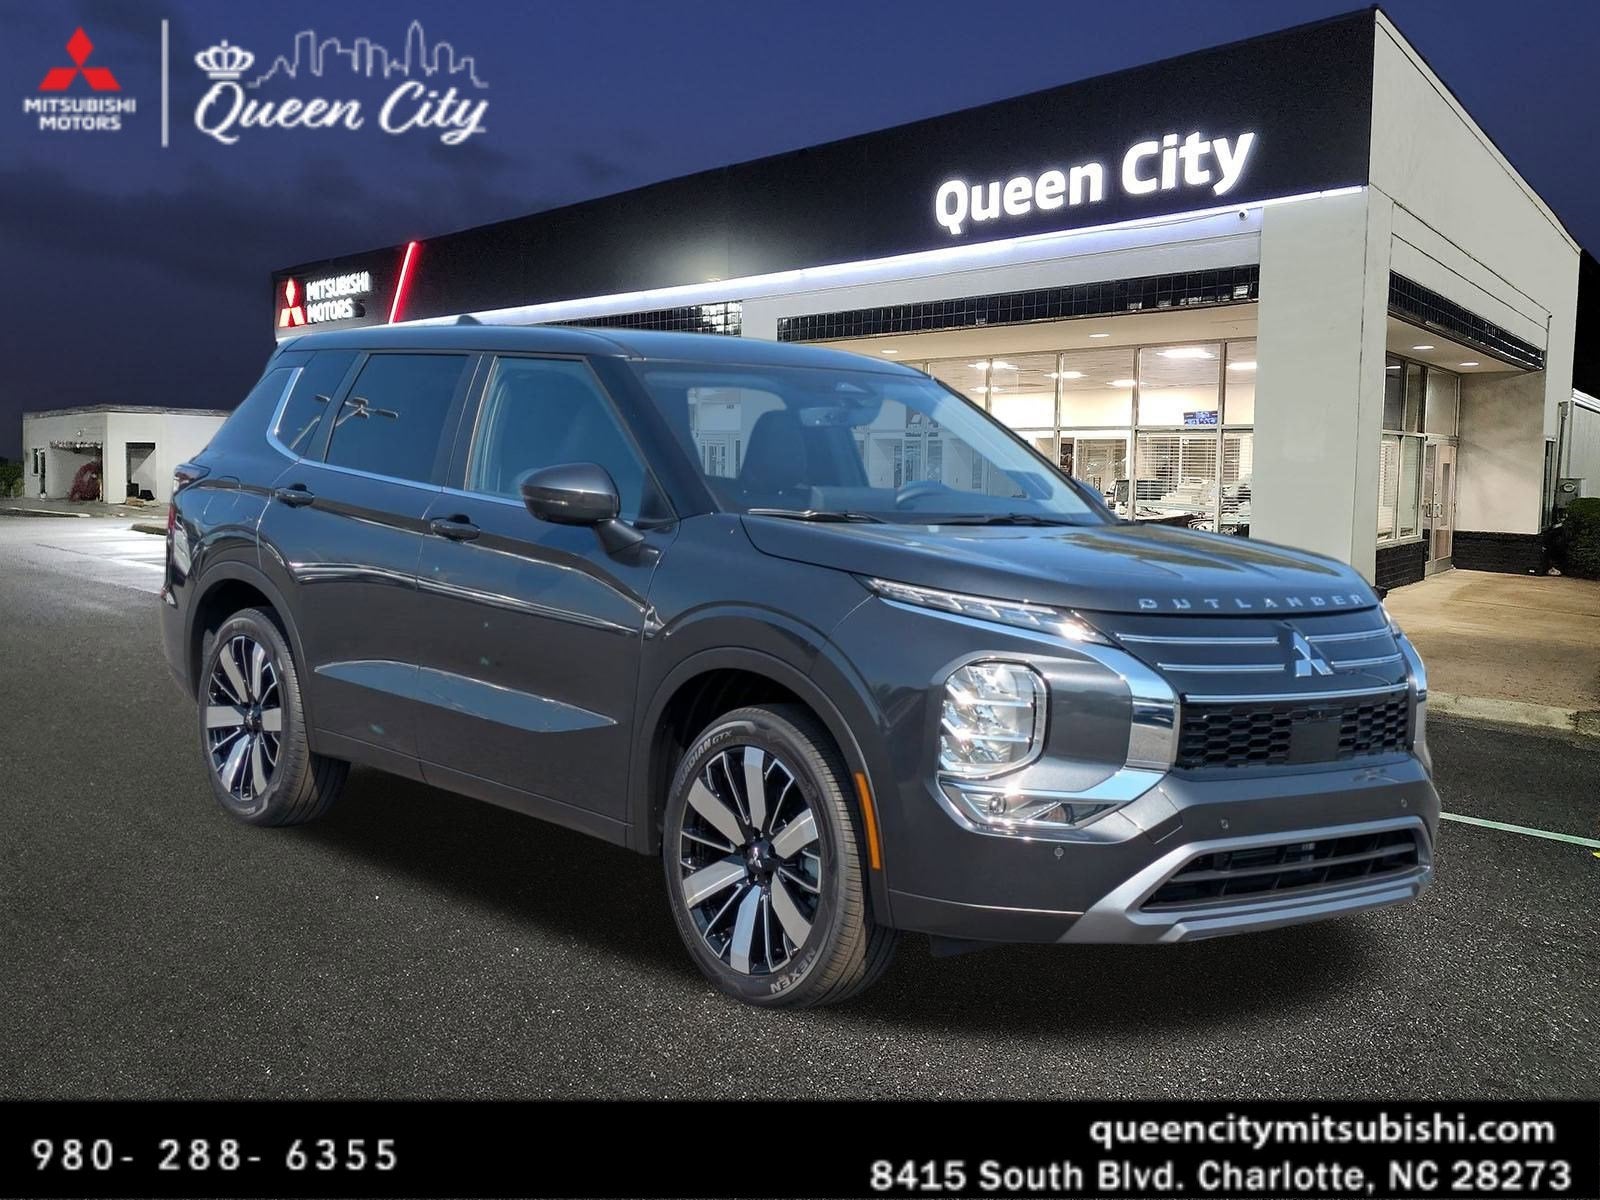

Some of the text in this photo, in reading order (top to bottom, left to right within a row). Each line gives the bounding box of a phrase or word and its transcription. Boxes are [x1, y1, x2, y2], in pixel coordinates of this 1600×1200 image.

[935, 131, 1256, 235] Queen City
[305, 270, 371, 302] MITSUBISHI
[306, 297, 354, 324] MOTORS
[1138, 594, 1364, 610] OUTLANDER
